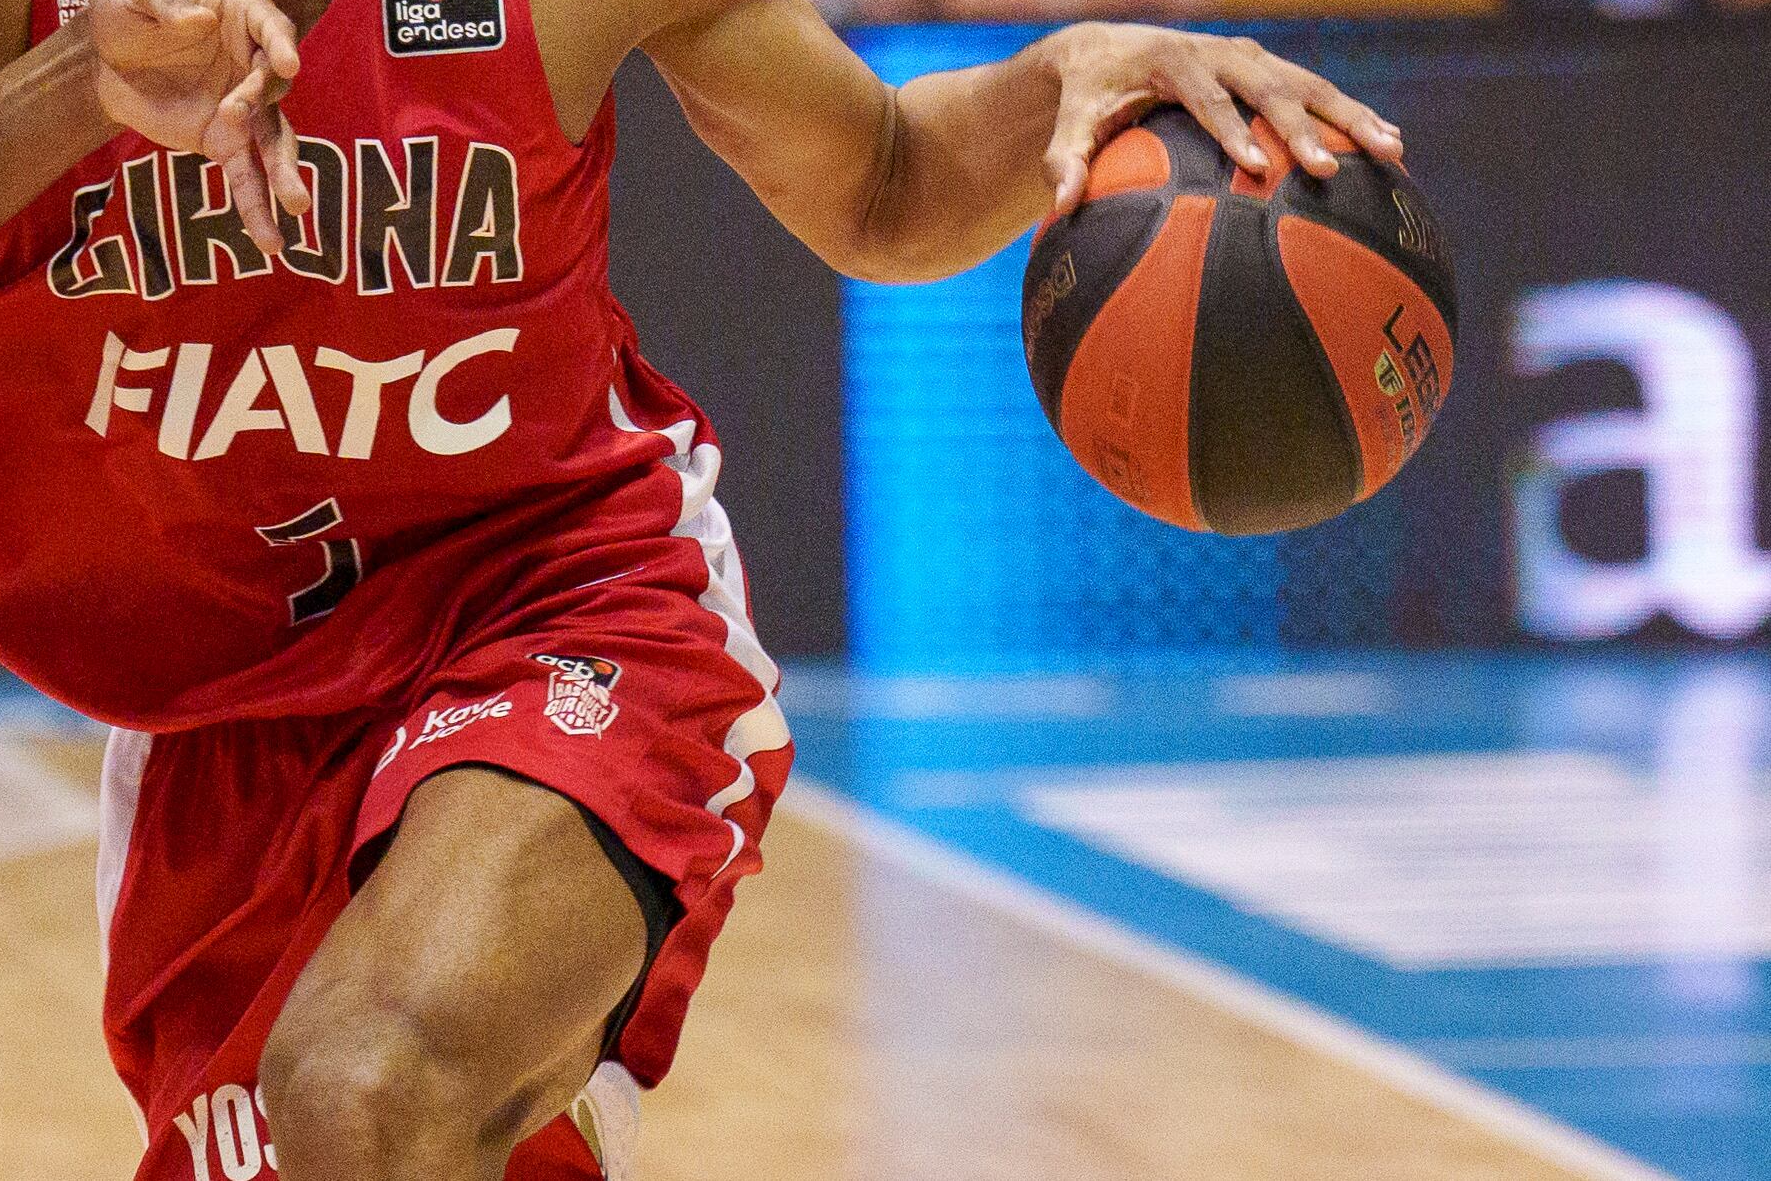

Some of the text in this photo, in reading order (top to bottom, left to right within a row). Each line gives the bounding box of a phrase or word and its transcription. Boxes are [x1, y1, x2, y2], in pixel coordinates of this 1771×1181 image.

[395, 0, 441, 24] liga
[397, 19, 496, 43] endesa
[46, 135, 524, 301] GIRONA
[83, 328, 521, 462] FIATC
[535, 655, 595, 680] acb
